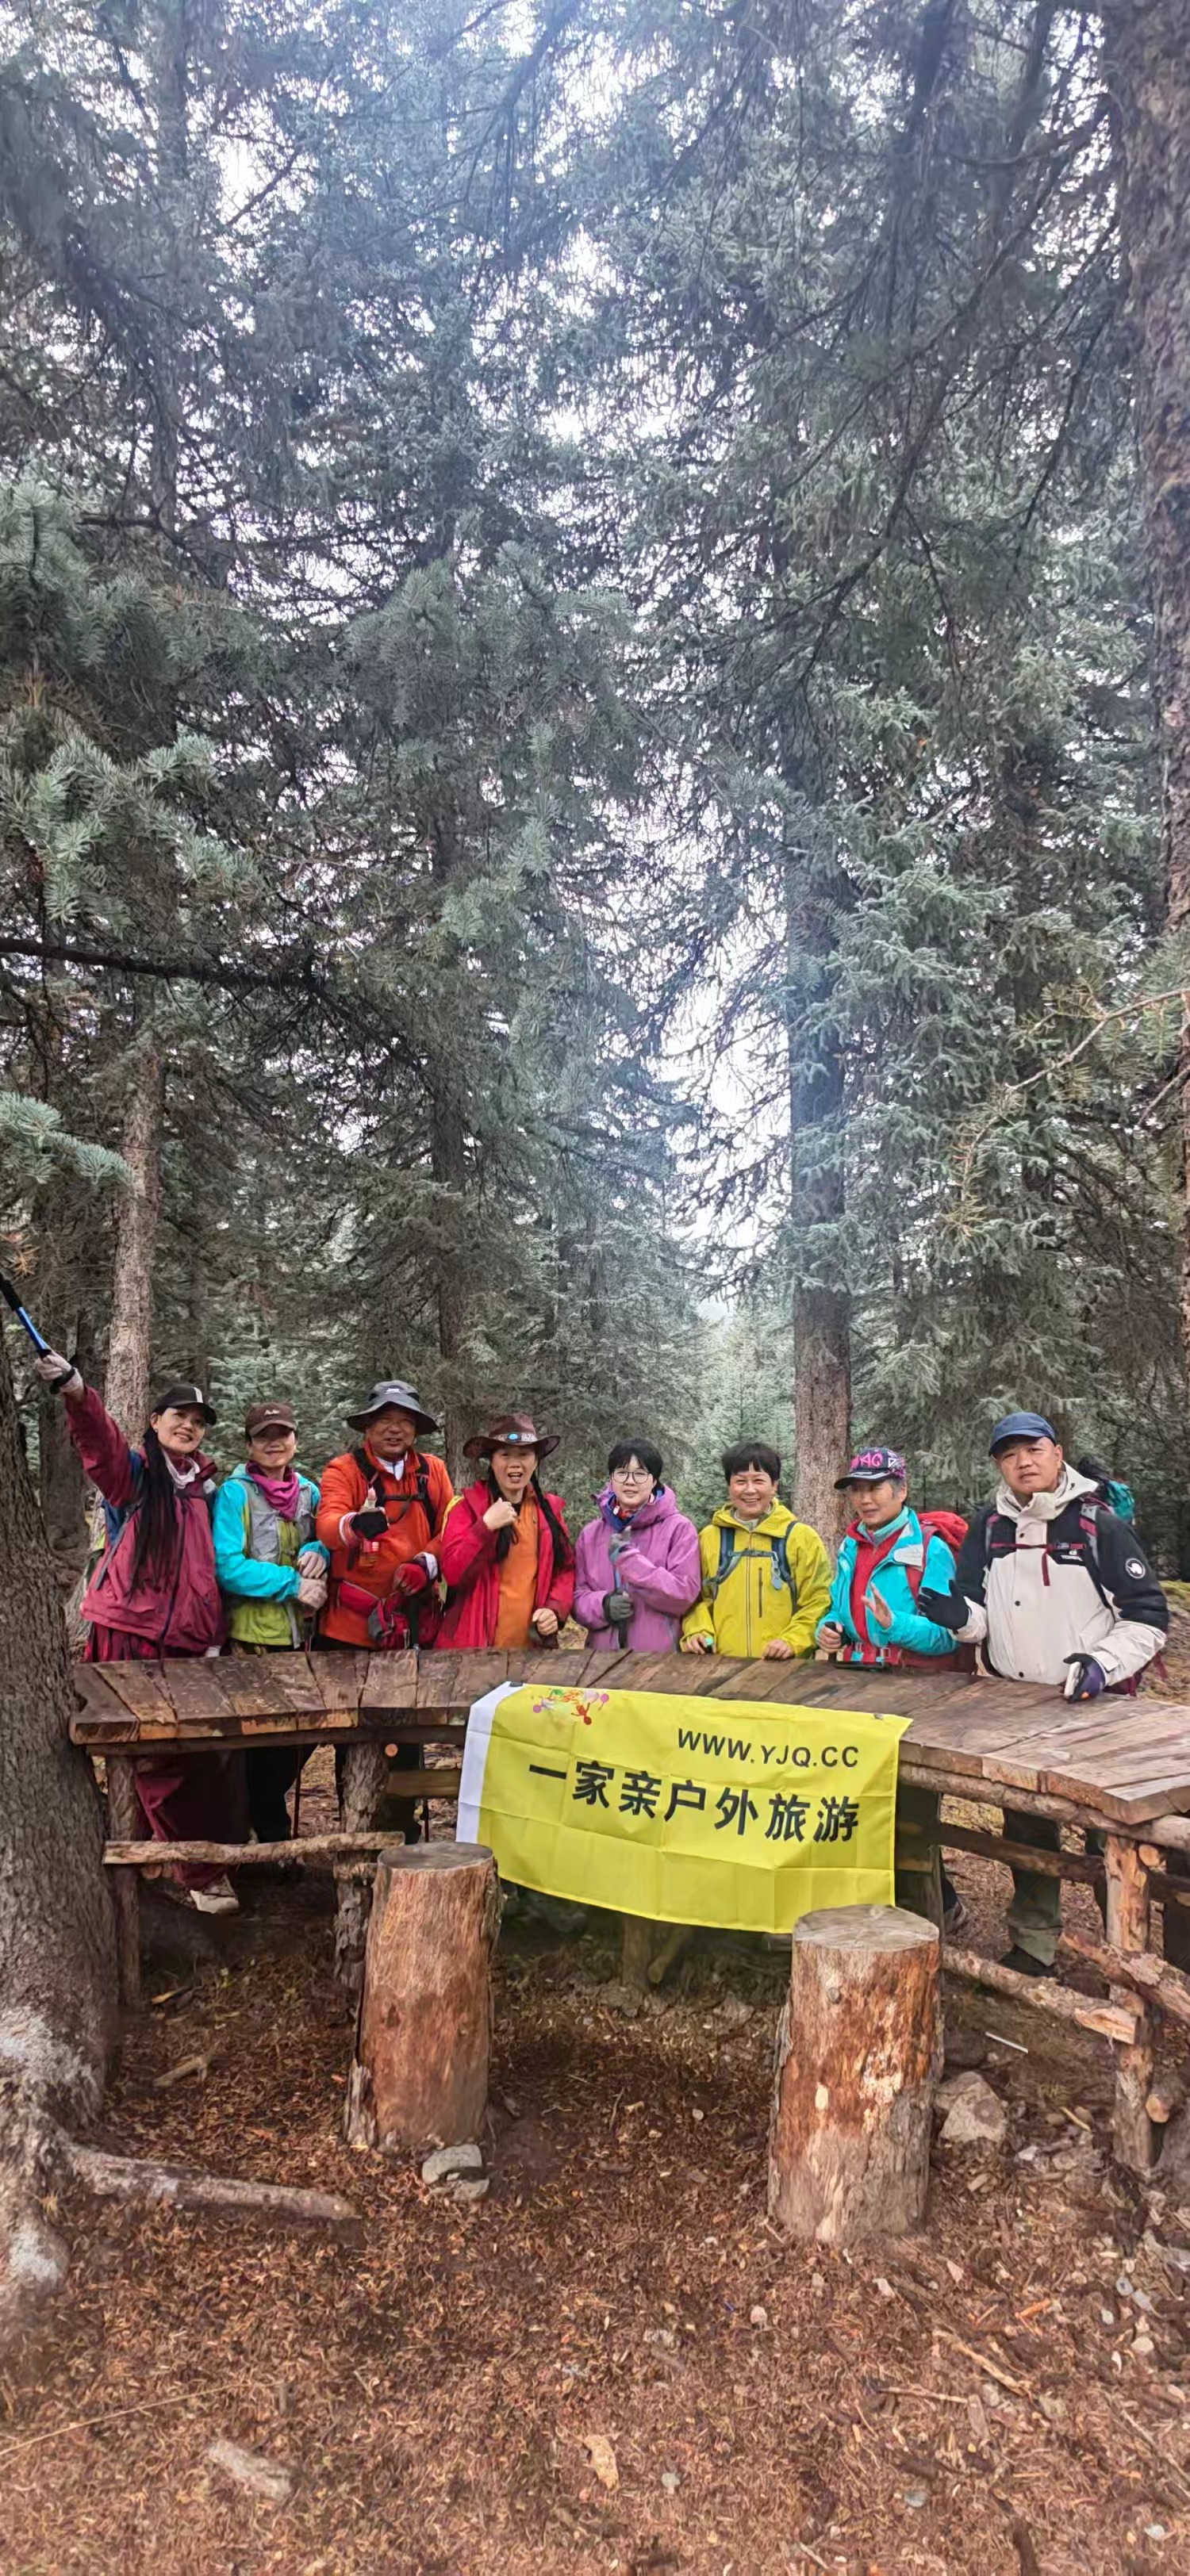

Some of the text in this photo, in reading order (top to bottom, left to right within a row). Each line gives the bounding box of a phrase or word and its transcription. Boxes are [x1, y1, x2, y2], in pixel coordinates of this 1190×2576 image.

[678, 1727, 858, 1769] WWW.YJQ.CC
[528, 1760, 860, 1843] 一家亲户外旅游
